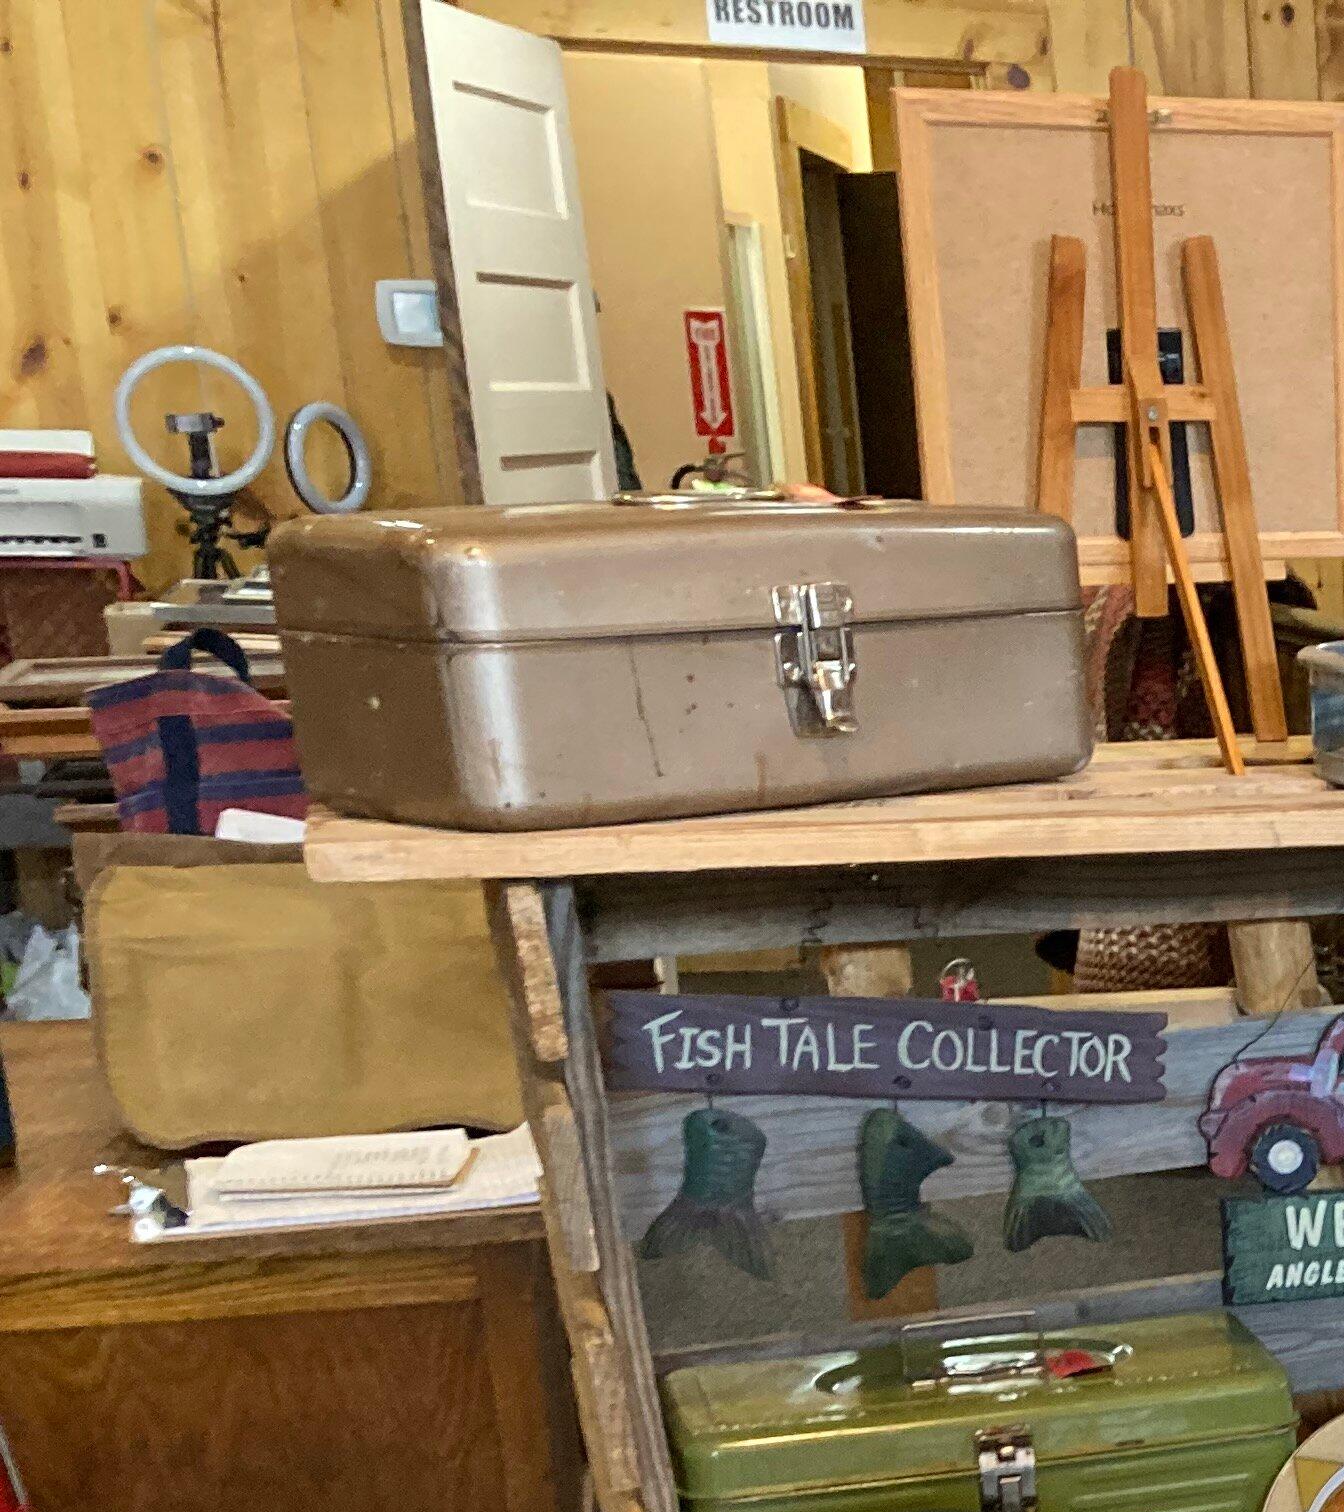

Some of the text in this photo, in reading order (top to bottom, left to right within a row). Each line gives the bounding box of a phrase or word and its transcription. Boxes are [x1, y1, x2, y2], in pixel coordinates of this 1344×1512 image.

[713, 0, 856, 30] RESTROOM
[641, 1010, 1132, 1083] FISH TALE COLLECTOR
